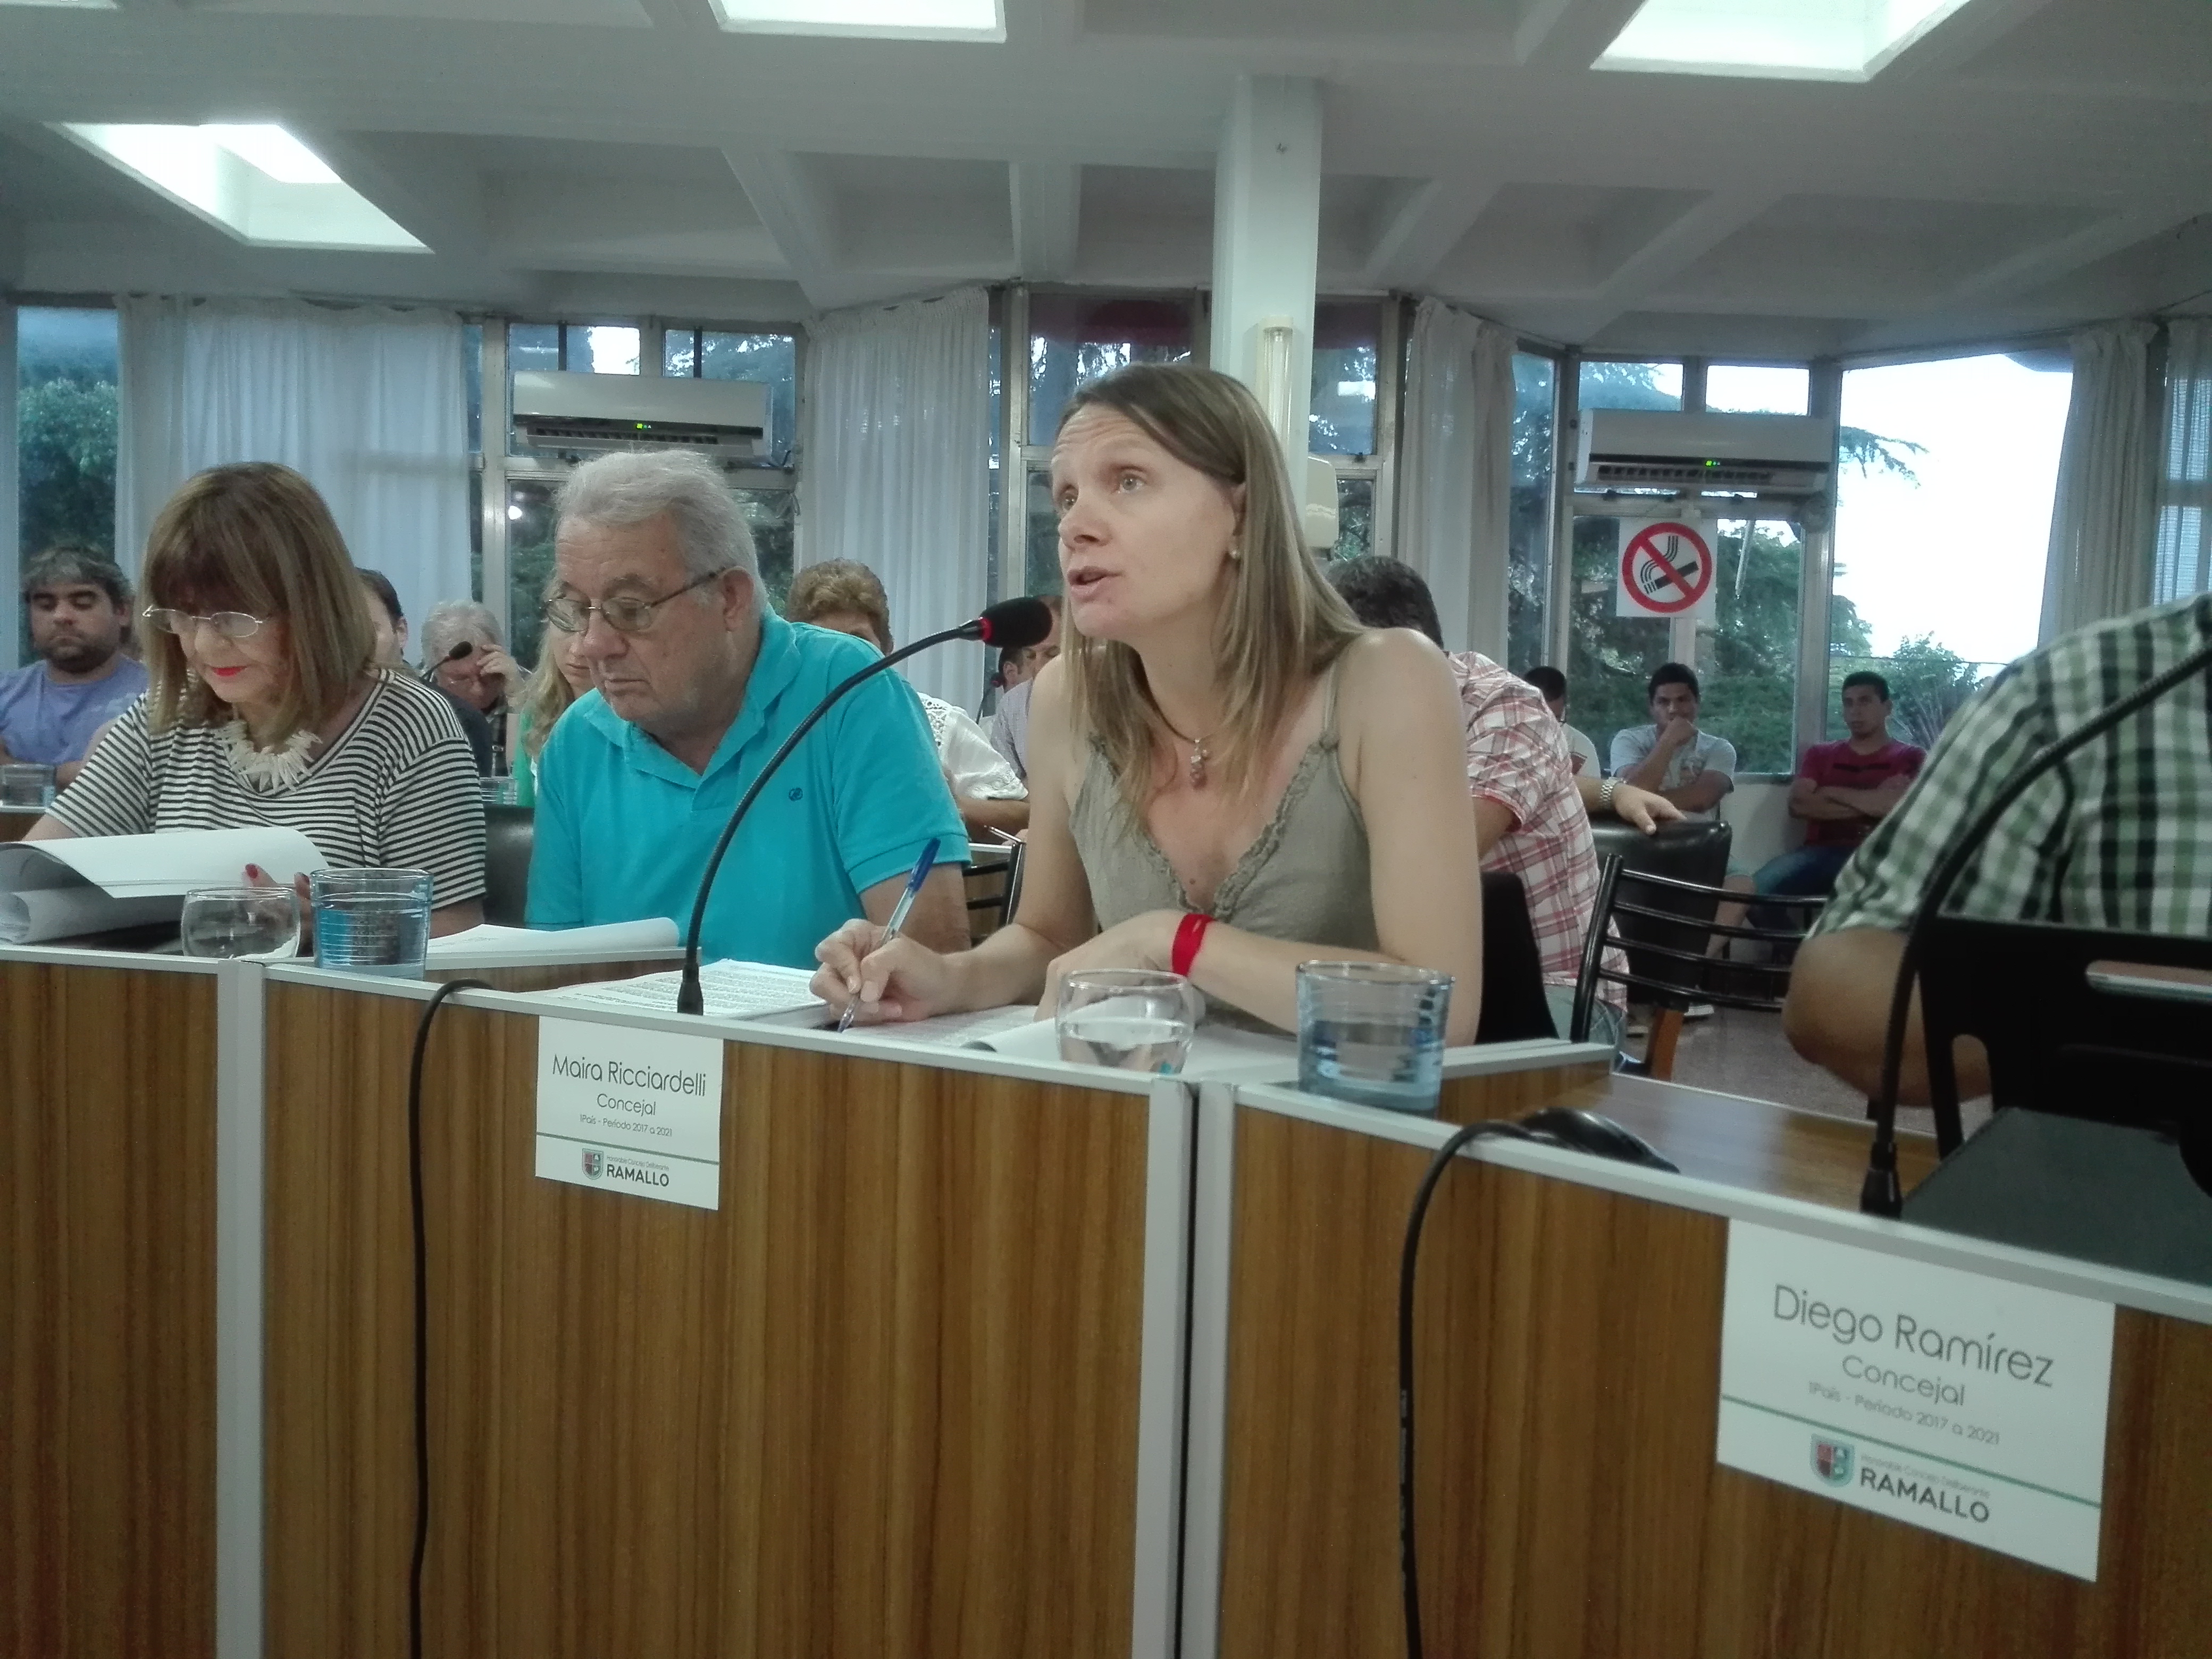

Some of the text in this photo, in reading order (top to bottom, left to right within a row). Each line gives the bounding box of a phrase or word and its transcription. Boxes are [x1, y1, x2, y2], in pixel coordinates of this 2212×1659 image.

[552, 1054, 706, 1096] Maira Ricciardelli
[597, 1093, 656, 1116] Concejal
[602, 1118, 631, 1130] Período
[632, 1122, 648, 1133] 2017
[656, 1127, 672, 1137] 2021
[607, 1164, 669, 1187] RAMALLO
[1774, 1284, 2053, 1387] Diego Ramírez
[1842, 1355, 1965, 1406] Concejal
[1916, 1411, 1948, 1429] 2017
[1952, 1423, 1963, 1436] a
[1967, 1425, 2000, 1445] 2021
[1861, 1467, 1989, 1523] RAMALLO
